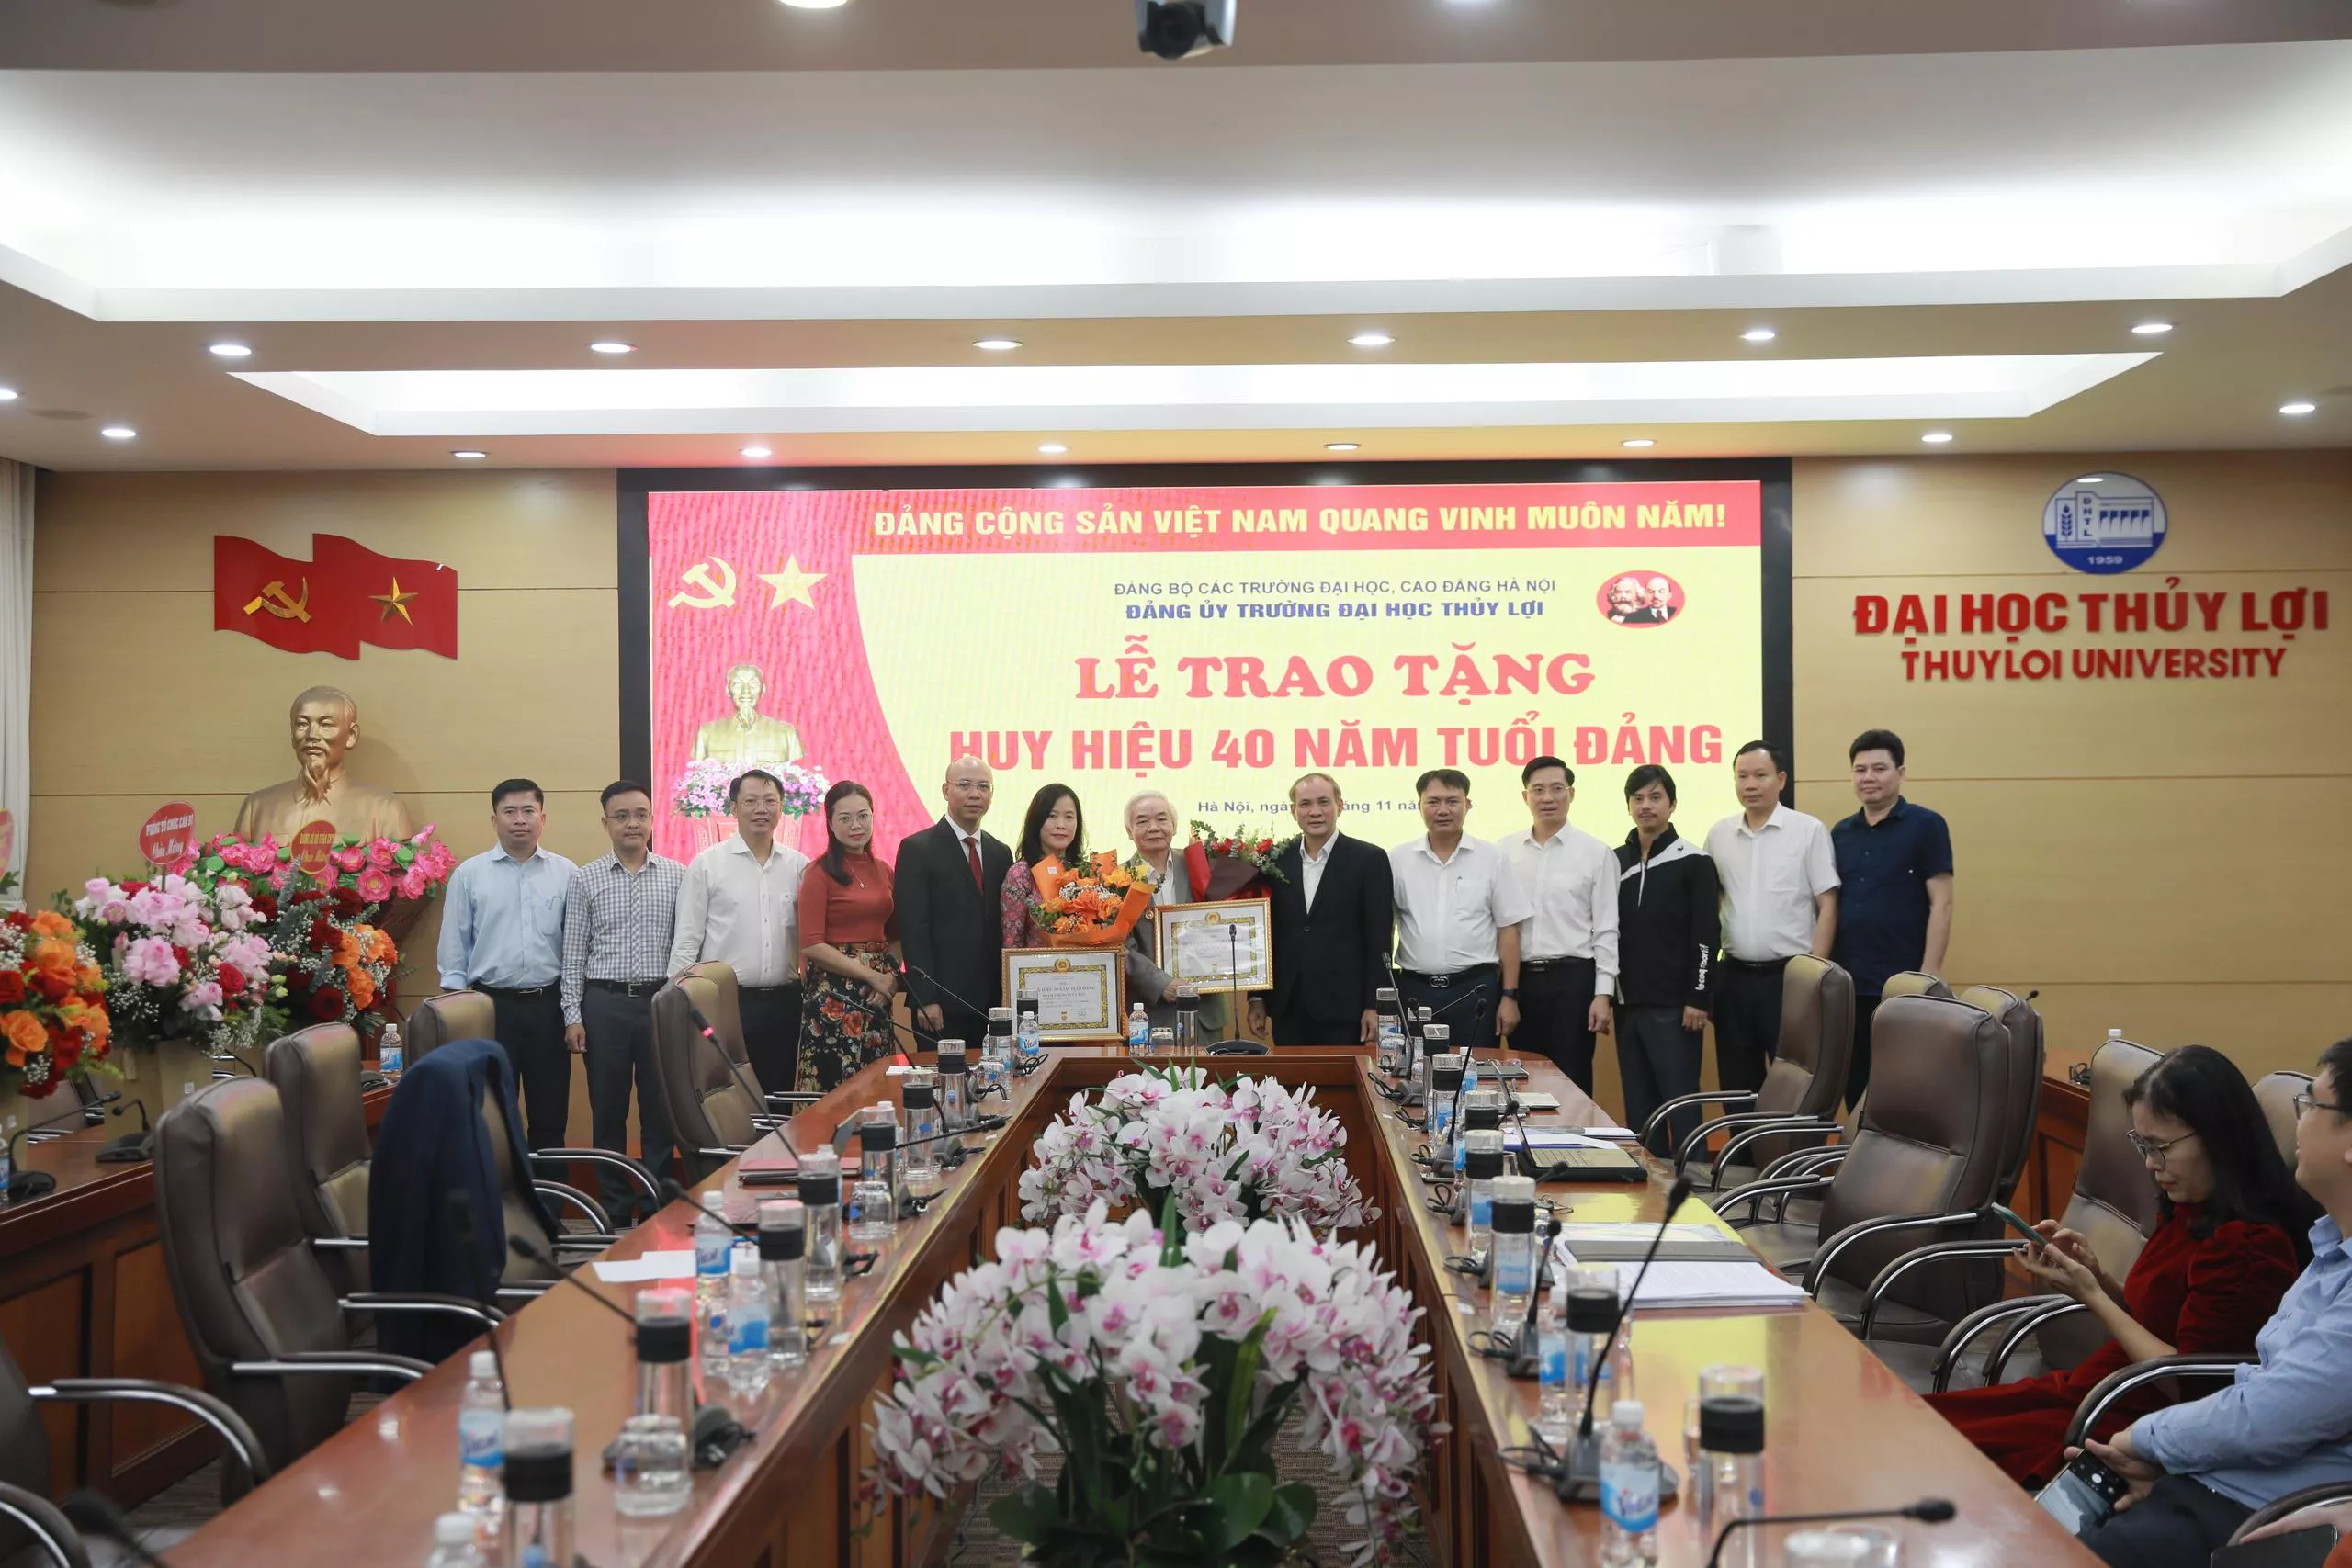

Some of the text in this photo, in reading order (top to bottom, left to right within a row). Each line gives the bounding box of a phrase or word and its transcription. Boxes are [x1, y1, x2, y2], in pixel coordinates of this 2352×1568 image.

[875, 500, 1725, 540] ĐẢNG CỘNG SẢN VIỆT NAM QUANG VINH MUÔN NĂM!
[2086, 555, 2124, 565] 1959
[1169, 581, 1193, 597] BỘ
[1198, 579, 1234, 595] CÁC
[1239, 578, 1315, 594] TRƯỜNG
[1320, 581, 1349, 596] ĐẠI
[1353, 581, 1396, 596] HỌC,
[1400, 581, 1438, 593] CAO
[1498, 576, 1521, 592] HÀ
[1526, 579, 1555, 594] NỘI
[1125, 597, 1544, 621] ĐẢNG ỦY TRƯỜNG ĐẠI HỌC THỦY LỢI
[1853, 576, 2329, 645] ĐẠI HỌC THỦY LỢI
[1074, 634, 1596, 705] LỄ TRAO TẶNG
[1901, 647, 2287, 681] THUYLOI UNIVERSITY
[950, 710, 1723, 778] HUY HIỆU 40 NĂM TUỔI ĐẢNG
[1198, 801, 1219, 812] Hà
[1260, 800, 1289, 815] ngà
[1342, 800, 1371, 814] áng
[1376, 800, 1392, 811] 11
[1398, 800, 1420, 811] nă
